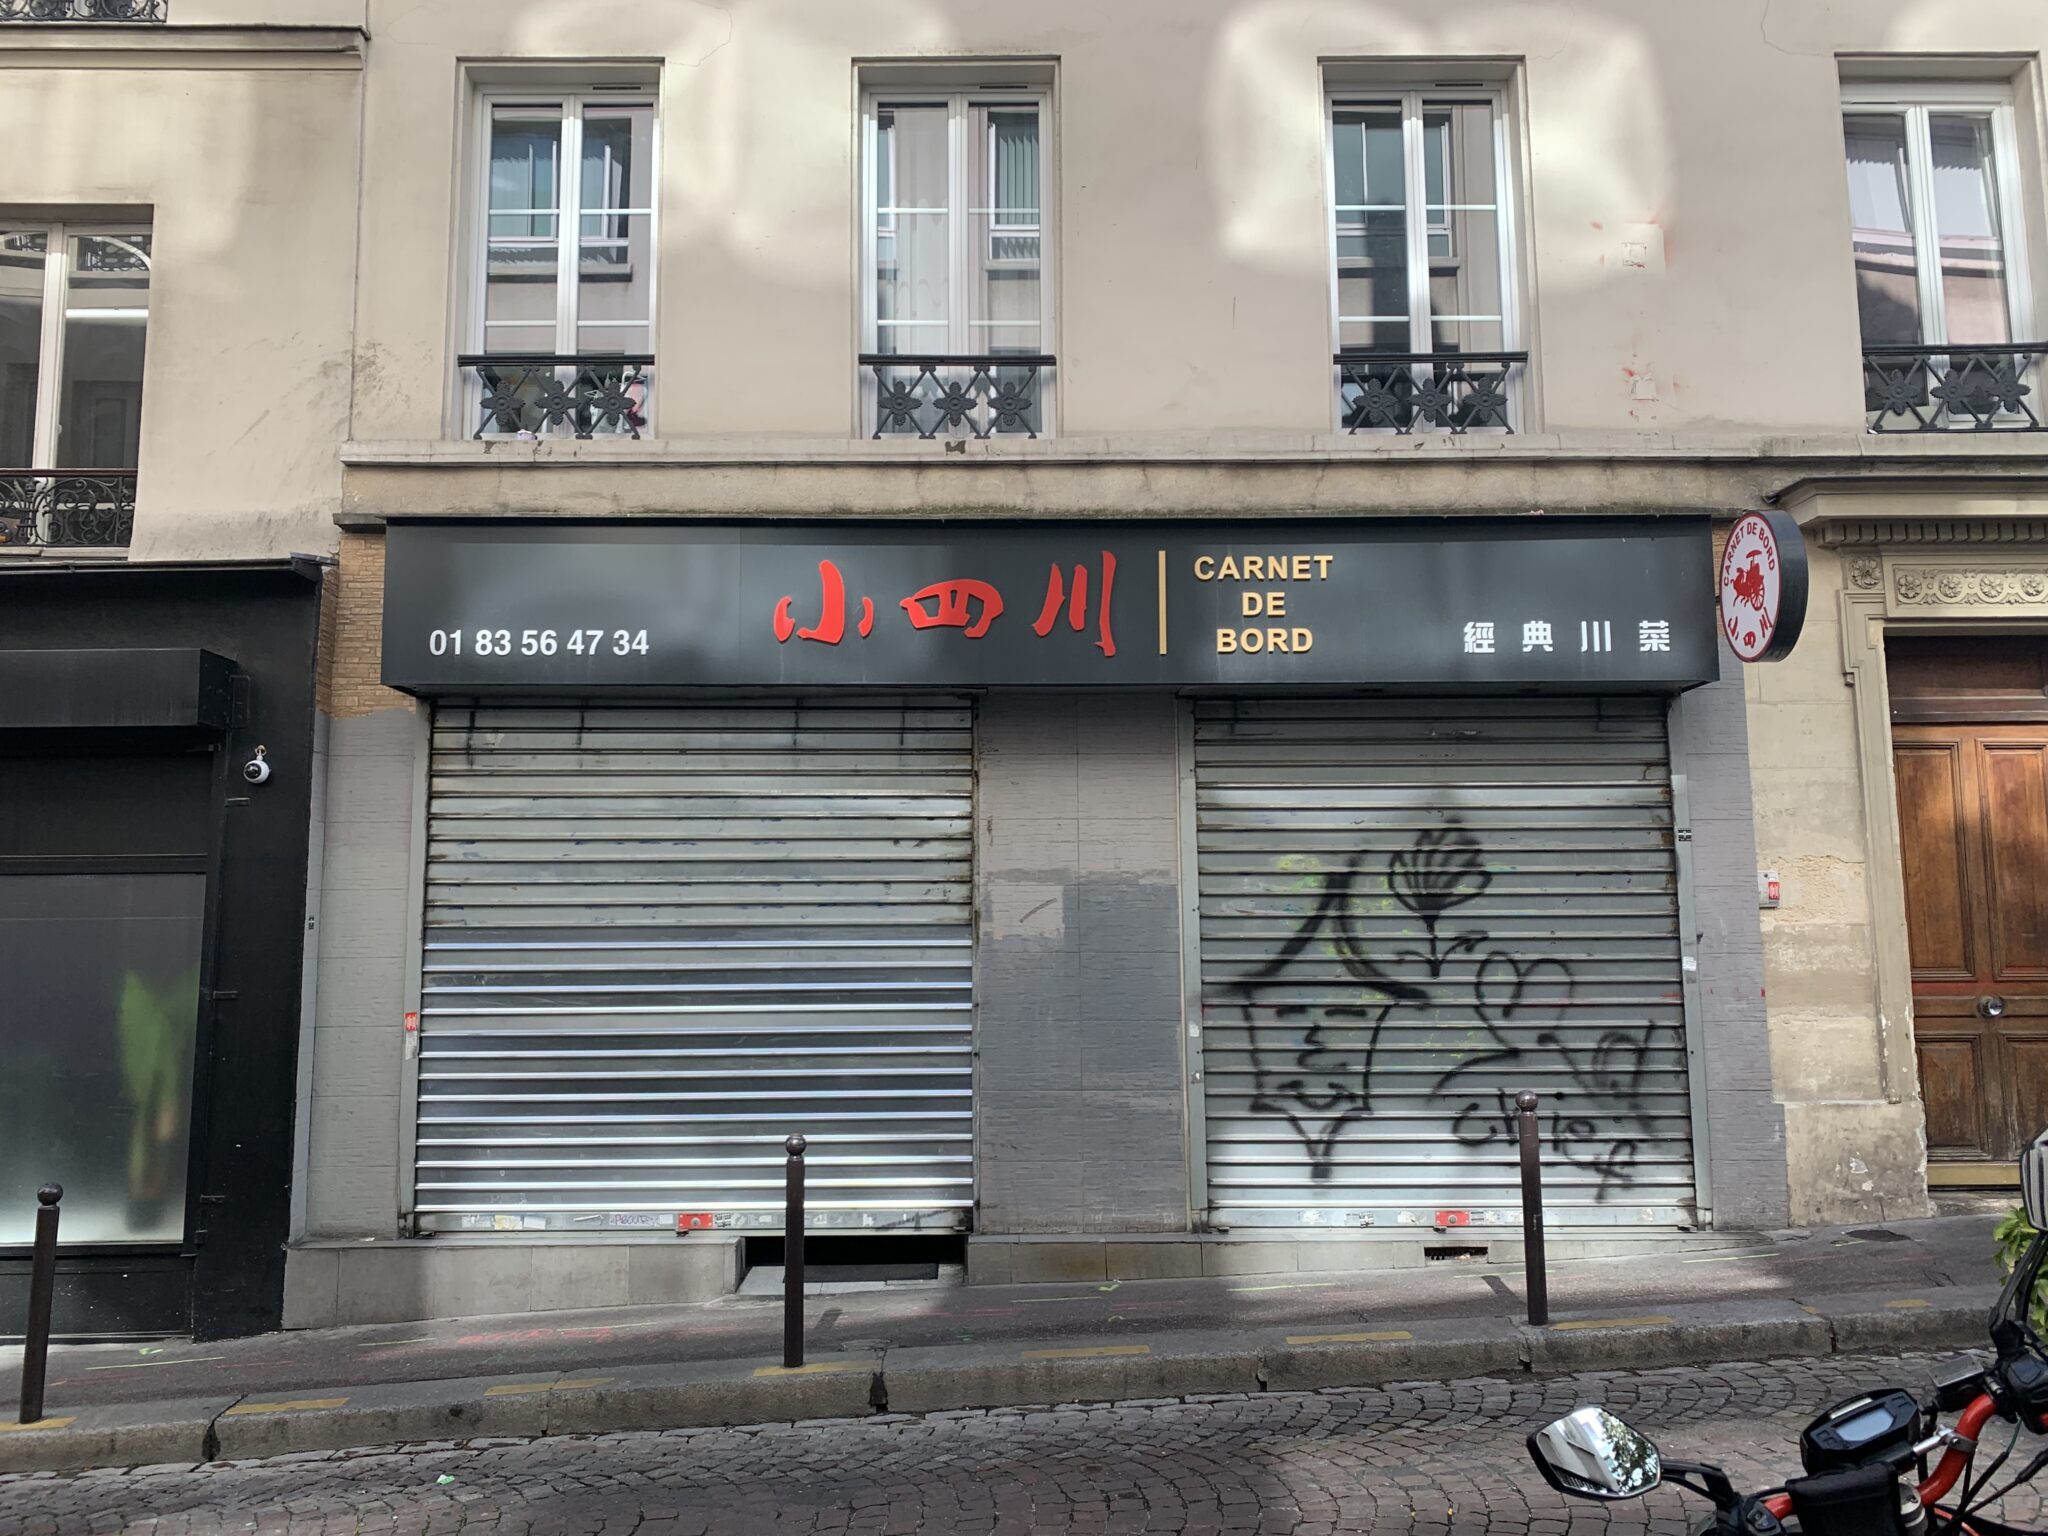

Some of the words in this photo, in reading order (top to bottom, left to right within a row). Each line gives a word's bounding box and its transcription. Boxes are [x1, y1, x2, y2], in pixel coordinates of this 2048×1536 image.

[1193, 556, 1333, 580] CARNET
[1723, 525, 1745, 587] CARNET
[1746, 522, 1758, 536] DE
[1758, 527, 1776, 571] BORD
[773, 550, 1118, 658] 小四川
[1241, 592, 1286, 617] DE
[429, 629, 462, 656] 01
[474, 629, 512, 656] 83
[520, 629, 558, 656] 56
[566, 629, 605, 656] 47
[612, 629, 650, 656] 34
[1215, 628, 1313, 654] BORD
[1463, 620, 1671, 654] 經典川菜
